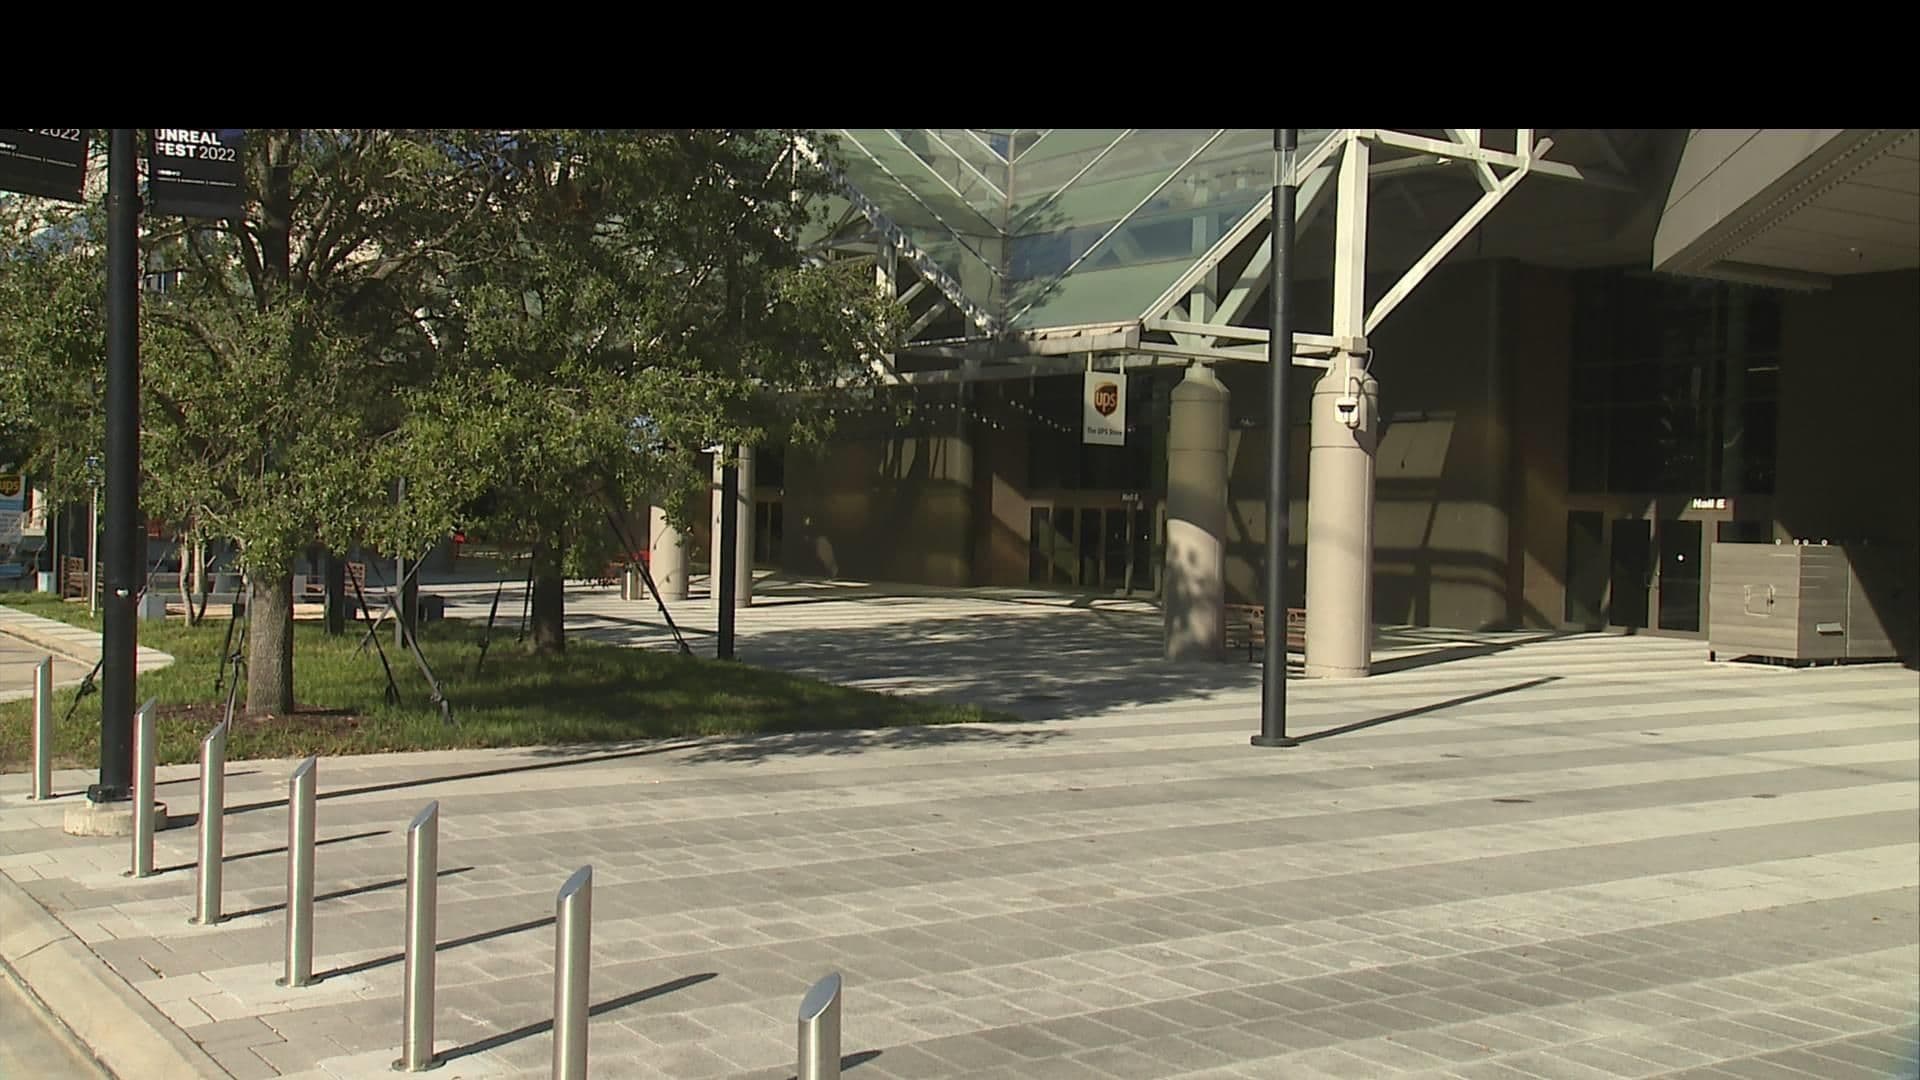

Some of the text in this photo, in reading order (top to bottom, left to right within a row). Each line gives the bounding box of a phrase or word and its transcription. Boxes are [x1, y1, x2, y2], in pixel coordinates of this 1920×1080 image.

[154, 129, 221, 145] UNREAL
[155, 142, 236, 162] FEST 2022
[1096, 391, 1116, 413] ups
[1087, 426, 1097, 434] The
[1692, 498, 1726, 509] Hall E
